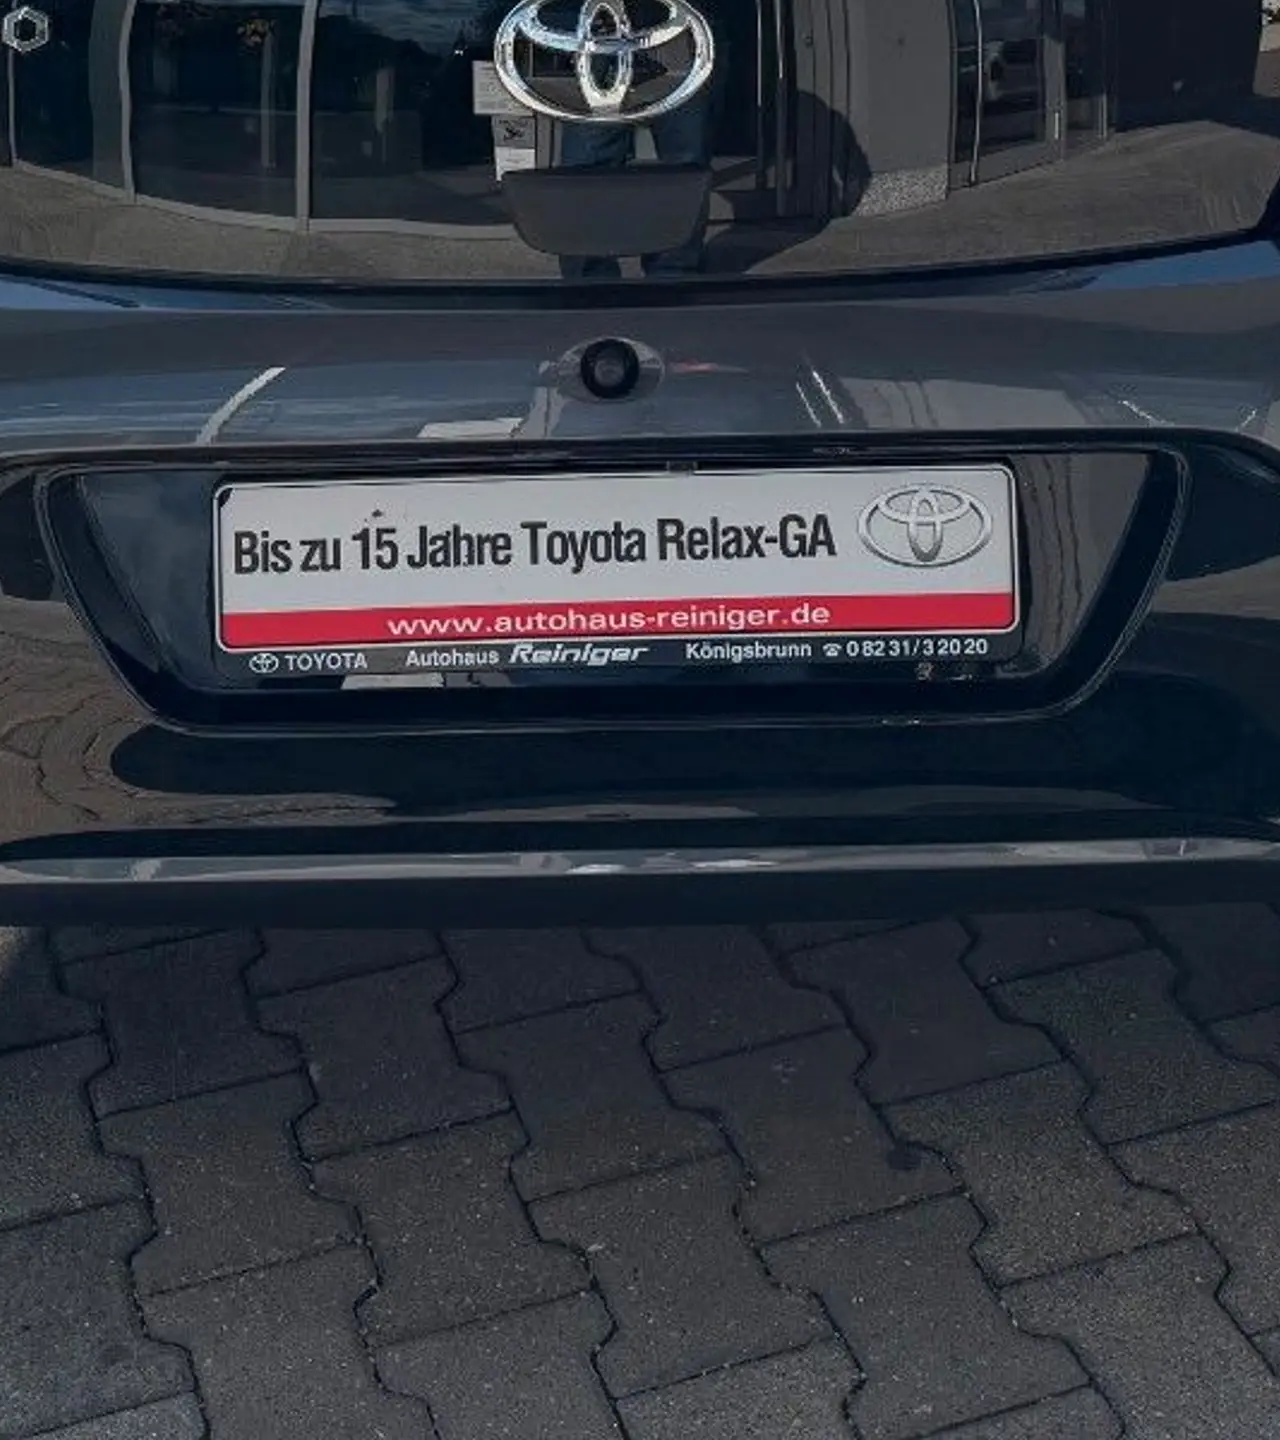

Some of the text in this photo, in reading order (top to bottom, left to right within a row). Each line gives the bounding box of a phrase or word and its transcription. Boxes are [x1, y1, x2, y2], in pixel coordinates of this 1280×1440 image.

[234, 513, 837, 574] Bis zu 15 Jahre Toyota Relax-GA
[387, 602, 831, 635] www.autohaus-reiniger.de
[285, 652, 368, 671] TOYOTA
[406, 648, 500, 667] Autohaus
[508, 644, 648, 666] Reiniger
[686, 641, 812, 662] Königsbrunn
